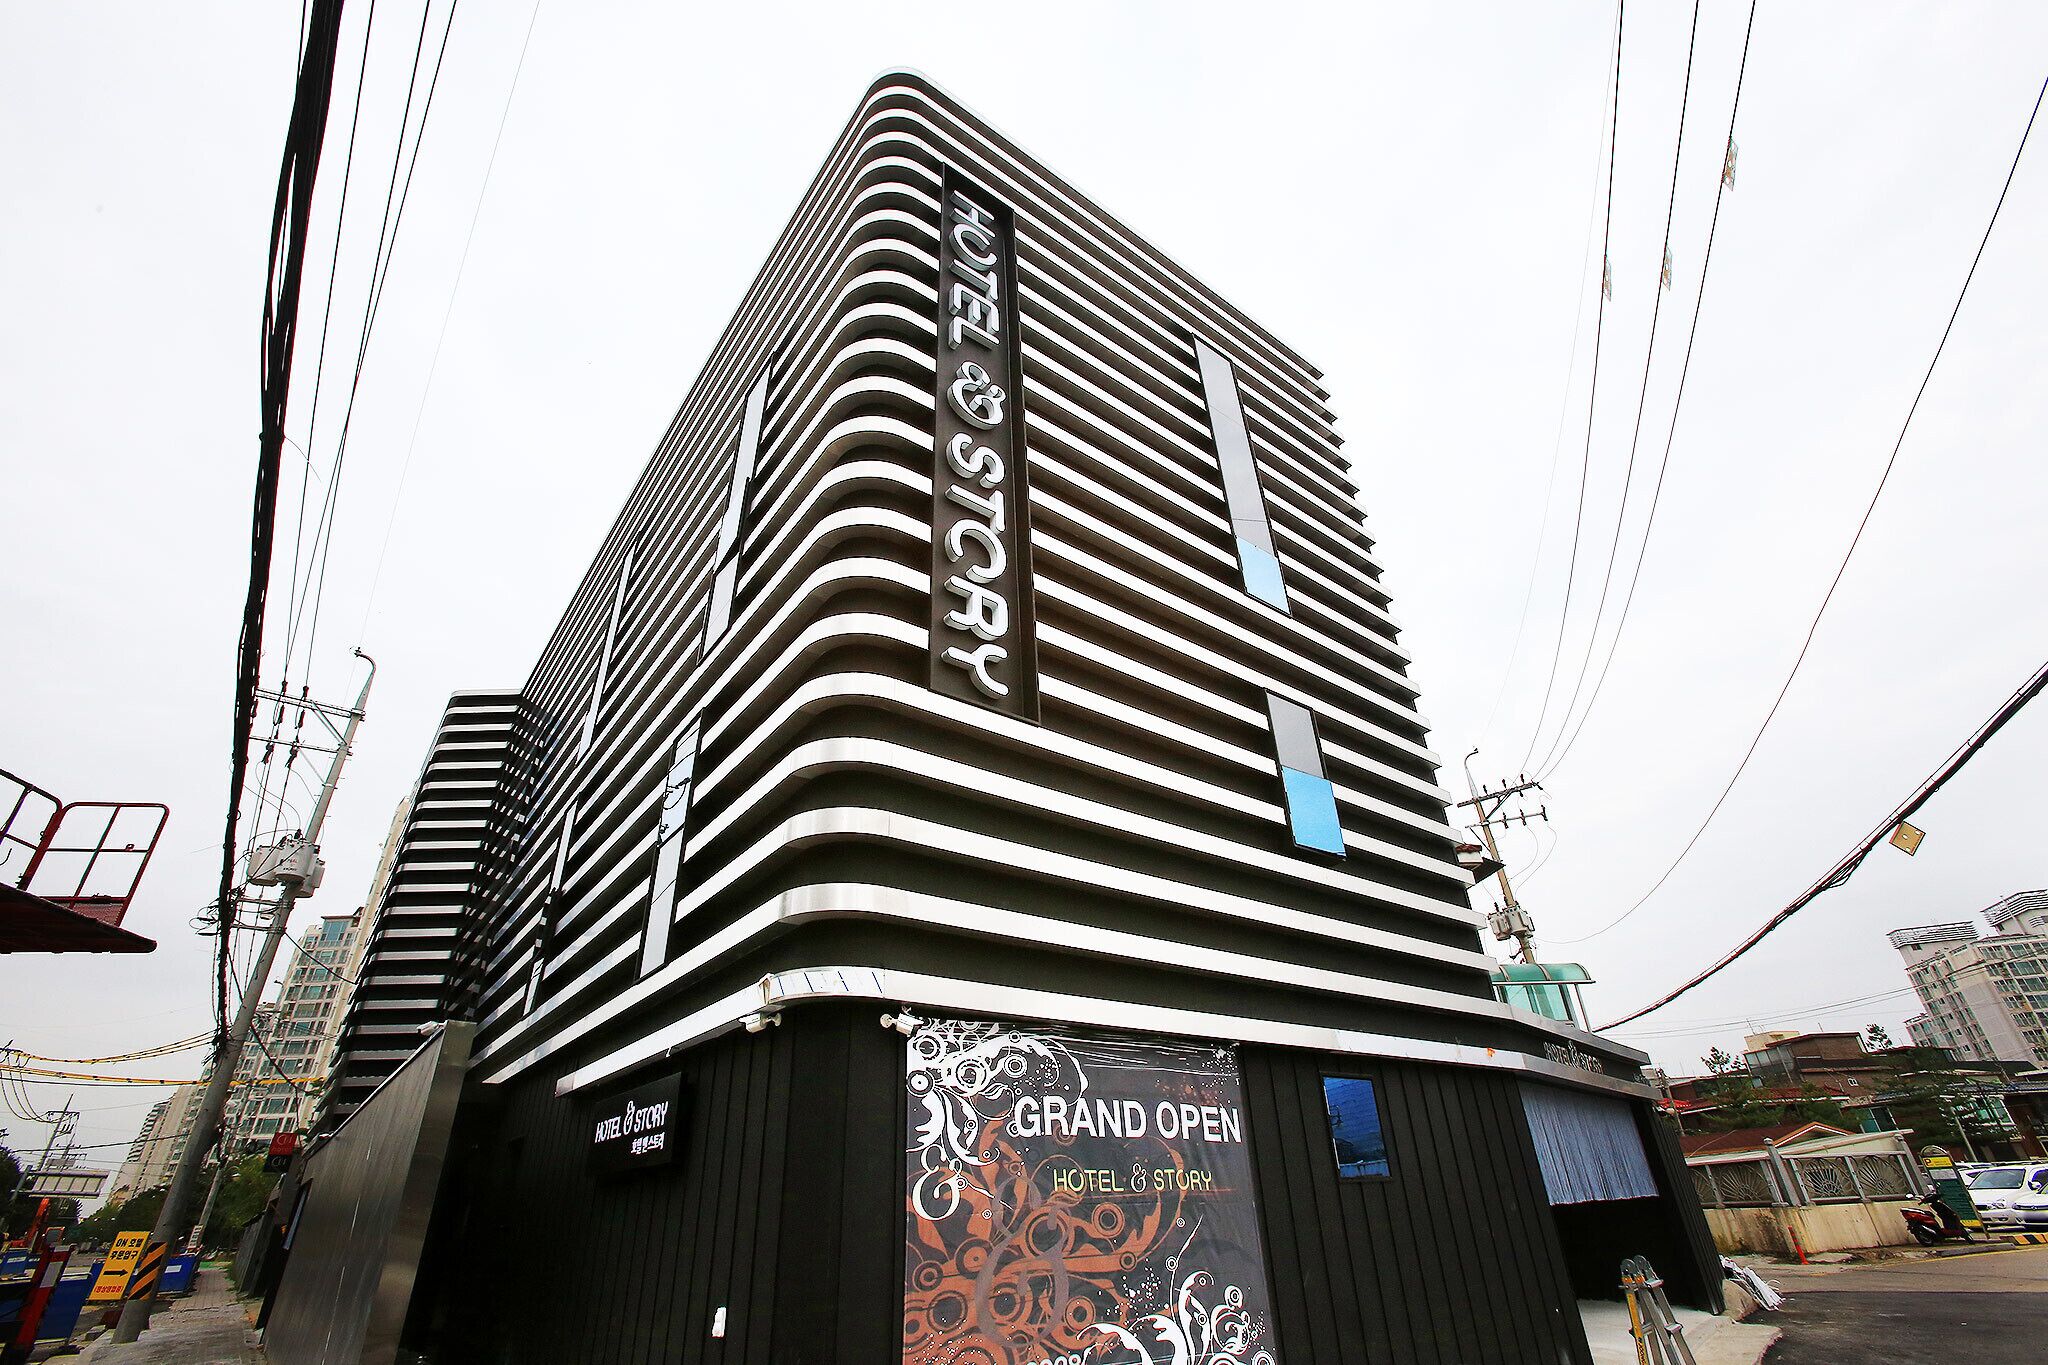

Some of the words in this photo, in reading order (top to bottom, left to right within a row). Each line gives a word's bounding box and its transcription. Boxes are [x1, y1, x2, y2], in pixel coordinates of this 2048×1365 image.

[949, 189, 1000, 350] HOTEL
[941, 432, 1010, 700] STORY
[594, 1115, 622, 1143] HOTEL
[634, 1101, 669, 1133] STORY
[1013, 1095, 1148, 1138] GRAND
[1155, 1100, 1242, 1143] OPEN
[1052, 1167, 1125, 1193] HOTEL
[1153, 1168, 1213, 1192] STORY
